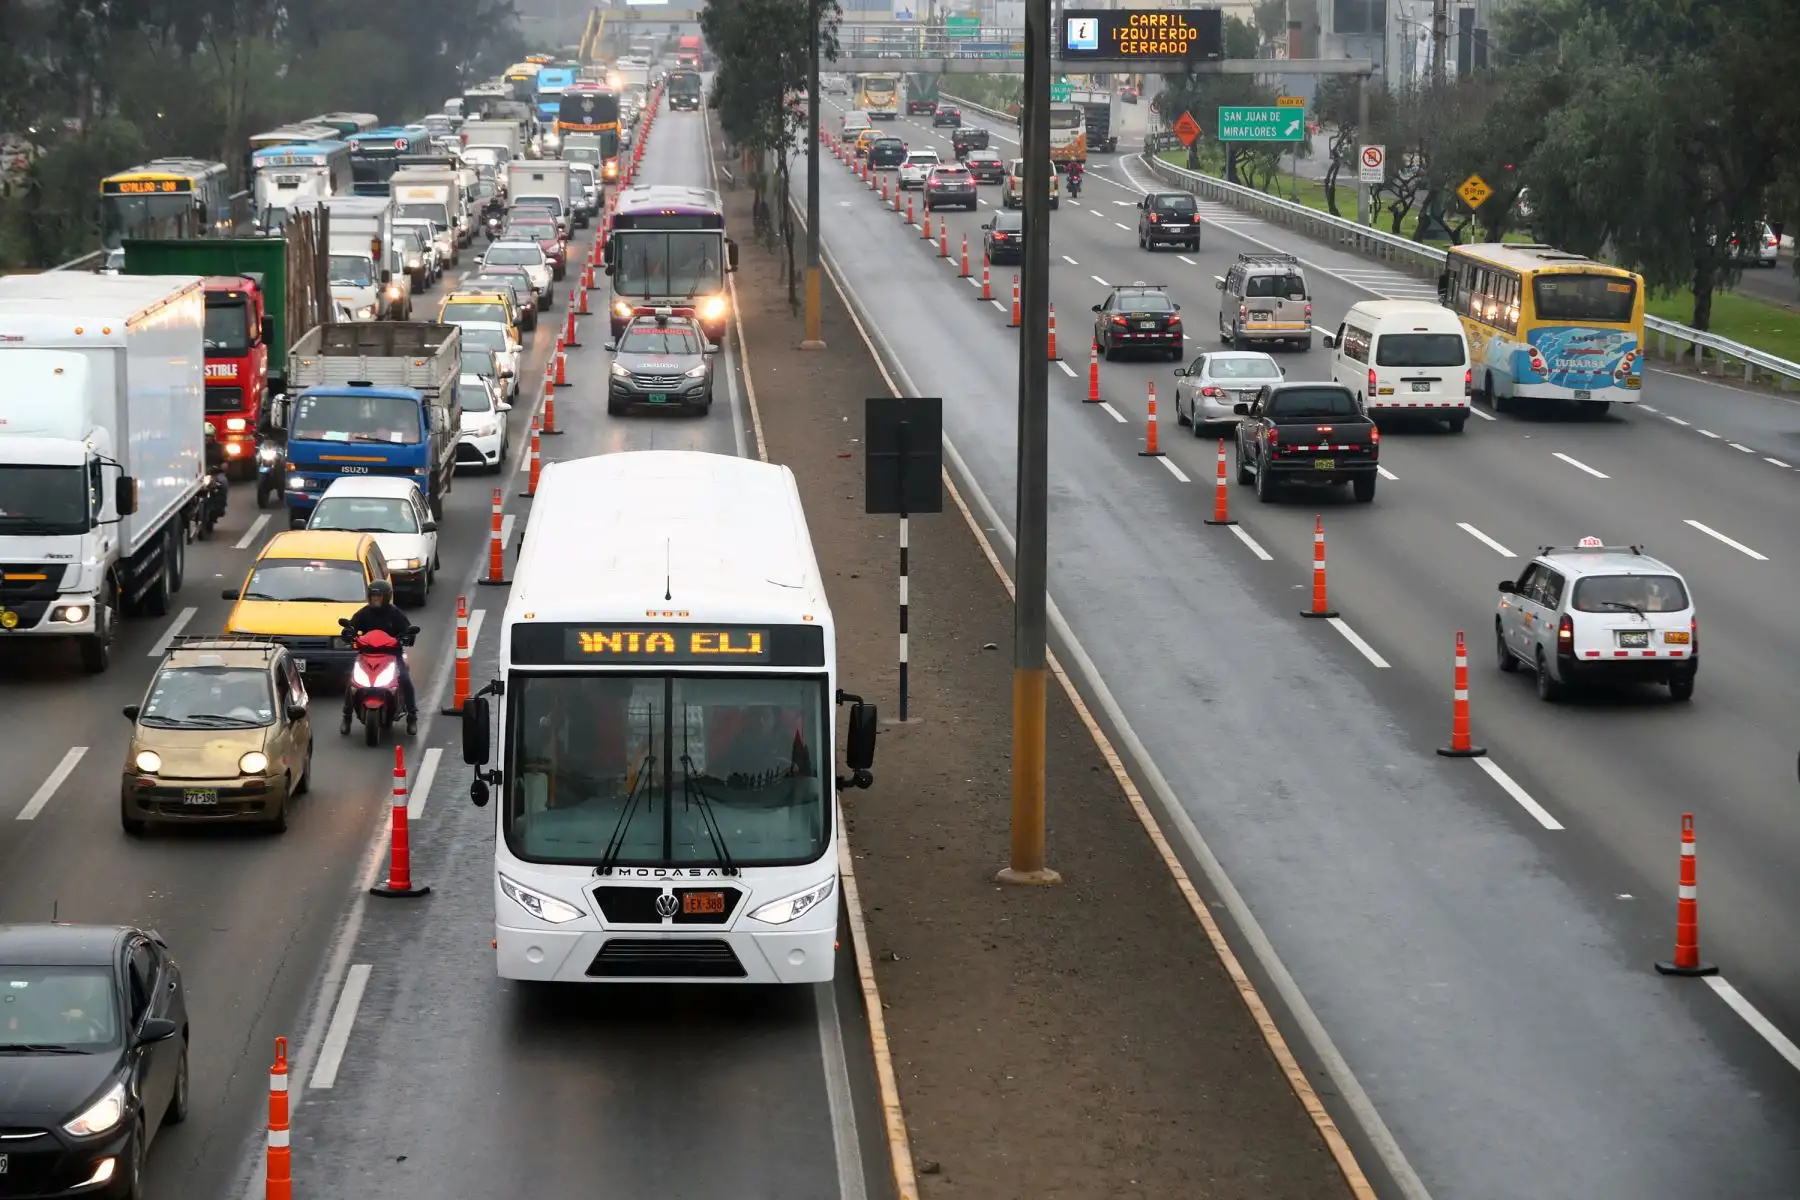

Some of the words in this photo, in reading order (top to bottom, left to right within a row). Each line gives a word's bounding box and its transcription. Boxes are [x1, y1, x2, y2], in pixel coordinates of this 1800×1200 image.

[1129, 14, 1187, 26] CARRIL
[1112, 28, 1197, 40] IZQUIERDO
[1120, 41, 1188, 53] CERRADO
[1224, 112, 1242, 121] SAN
[1246, 112, 1267, 122] JUAN
[1270, 112, 1280, 122] DE
[1223, 127, 1277, 137] MIRAFLORES
[341, 466, 369, 474] ISUZU
[618, 869, 718, 877] MODASA
